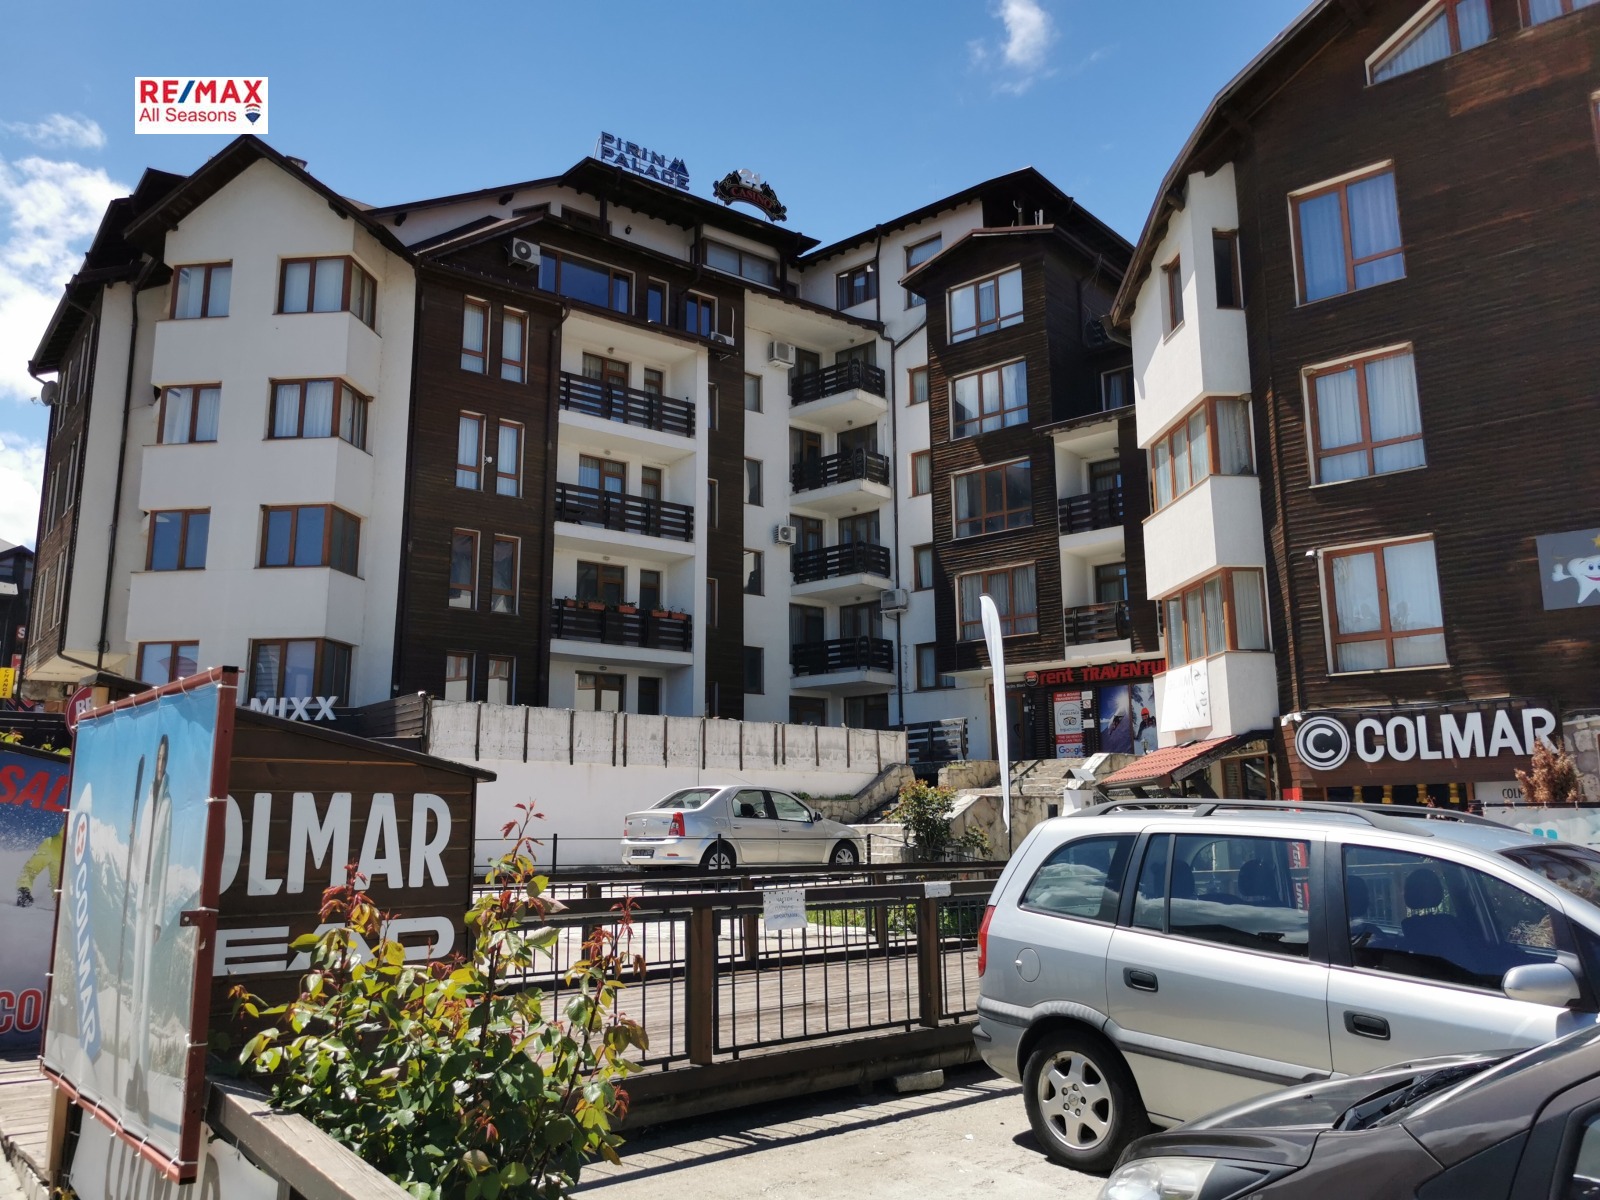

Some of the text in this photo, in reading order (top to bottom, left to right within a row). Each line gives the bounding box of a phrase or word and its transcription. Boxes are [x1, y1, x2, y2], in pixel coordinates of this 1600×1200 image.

[601, 131, 666, 168] PIRIN
[601, 145, 690, 191] PALACE
[731, 186, 773, 209] CASINO
[739, 168, 762, 191] 21
[1040, 667, 1074, 685] rent
[250, 695, 339, 721] MIXX
[1354, 707, 1558, 763] COLMAR
[0, 765, 70, 812] SAL
[219, 792, 452, 896] OLMAR
[76, 862, 96, 1051] COLMAR
[0, 988, 44, 1034] CO
